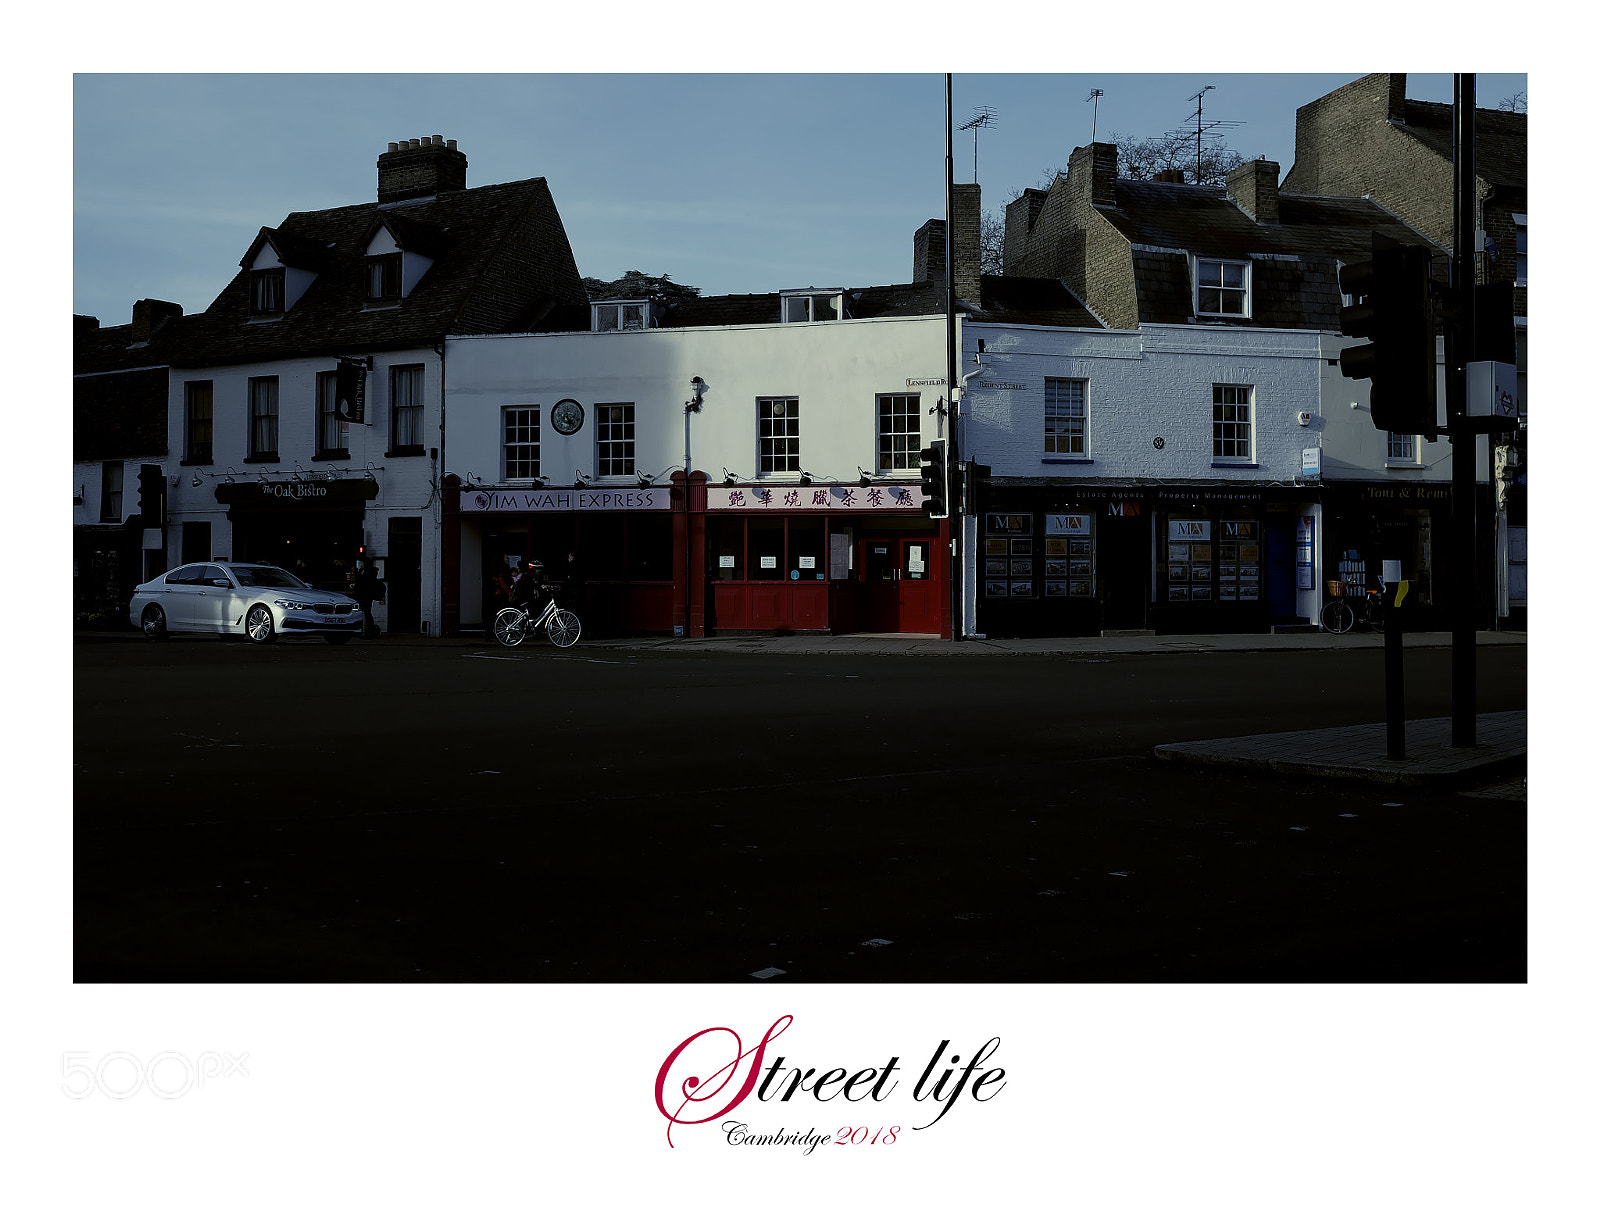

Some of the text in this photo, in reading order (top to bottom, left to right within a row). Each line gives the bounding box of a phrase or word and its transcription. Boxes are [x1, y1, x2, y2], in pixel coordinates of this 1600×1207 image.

[274, 484, 303, 500] Oak
[297, 483, 327, 497] Bistro
[1112, 491, 1144, 499] Agents
[1158, 491, 1200, 500] Property
[1204, 492, 1262, 500] Management
[1399, 487, 1411, 498] &
[482, 491, 653, 510] YIM WAH EXPRESS
